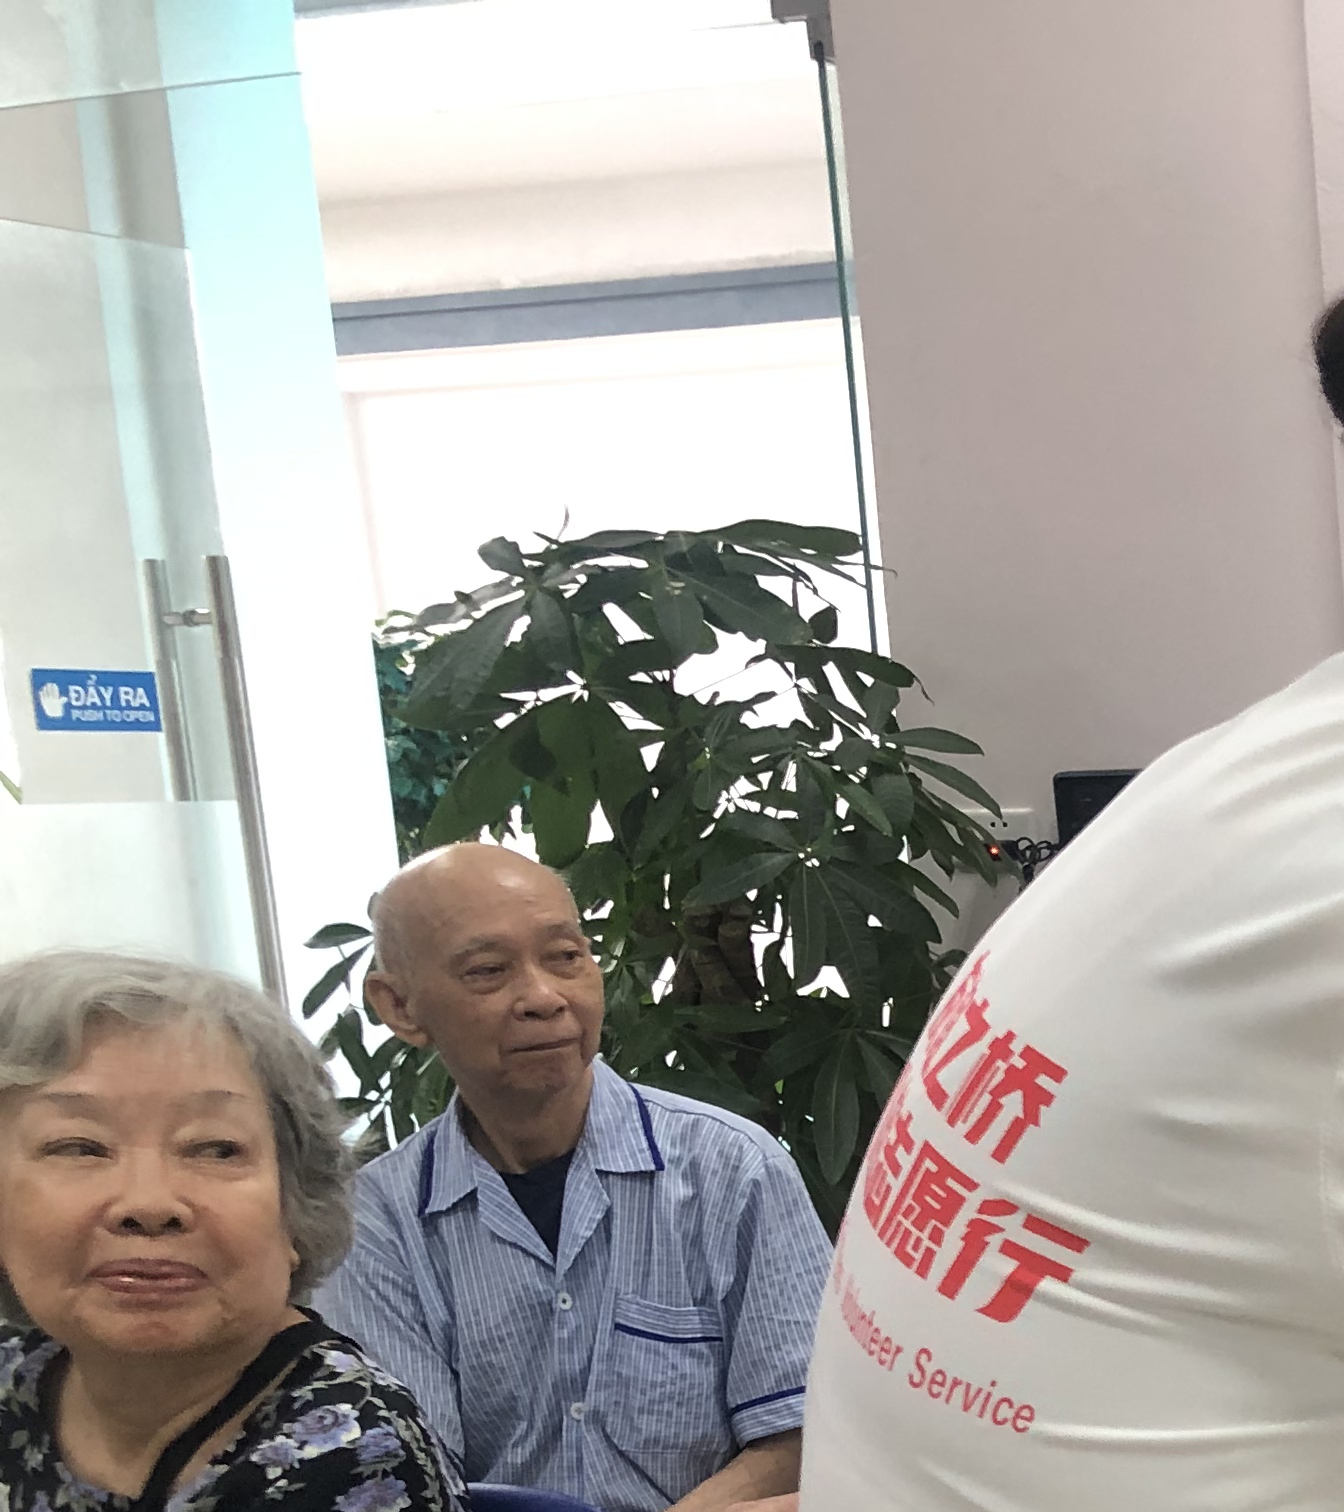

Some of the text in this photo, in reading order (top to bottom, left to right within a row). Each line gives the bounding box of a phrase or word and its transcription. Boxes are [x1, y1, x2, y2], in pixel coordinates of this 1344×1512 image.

[68, 674, 151, 708] ĐẨY RA
[70, 709, 156, 723] PUSH TO OPEN
[863, 1061, 1093, 1324] 志愿行
[908, 1347, 1036, 1434] Service
